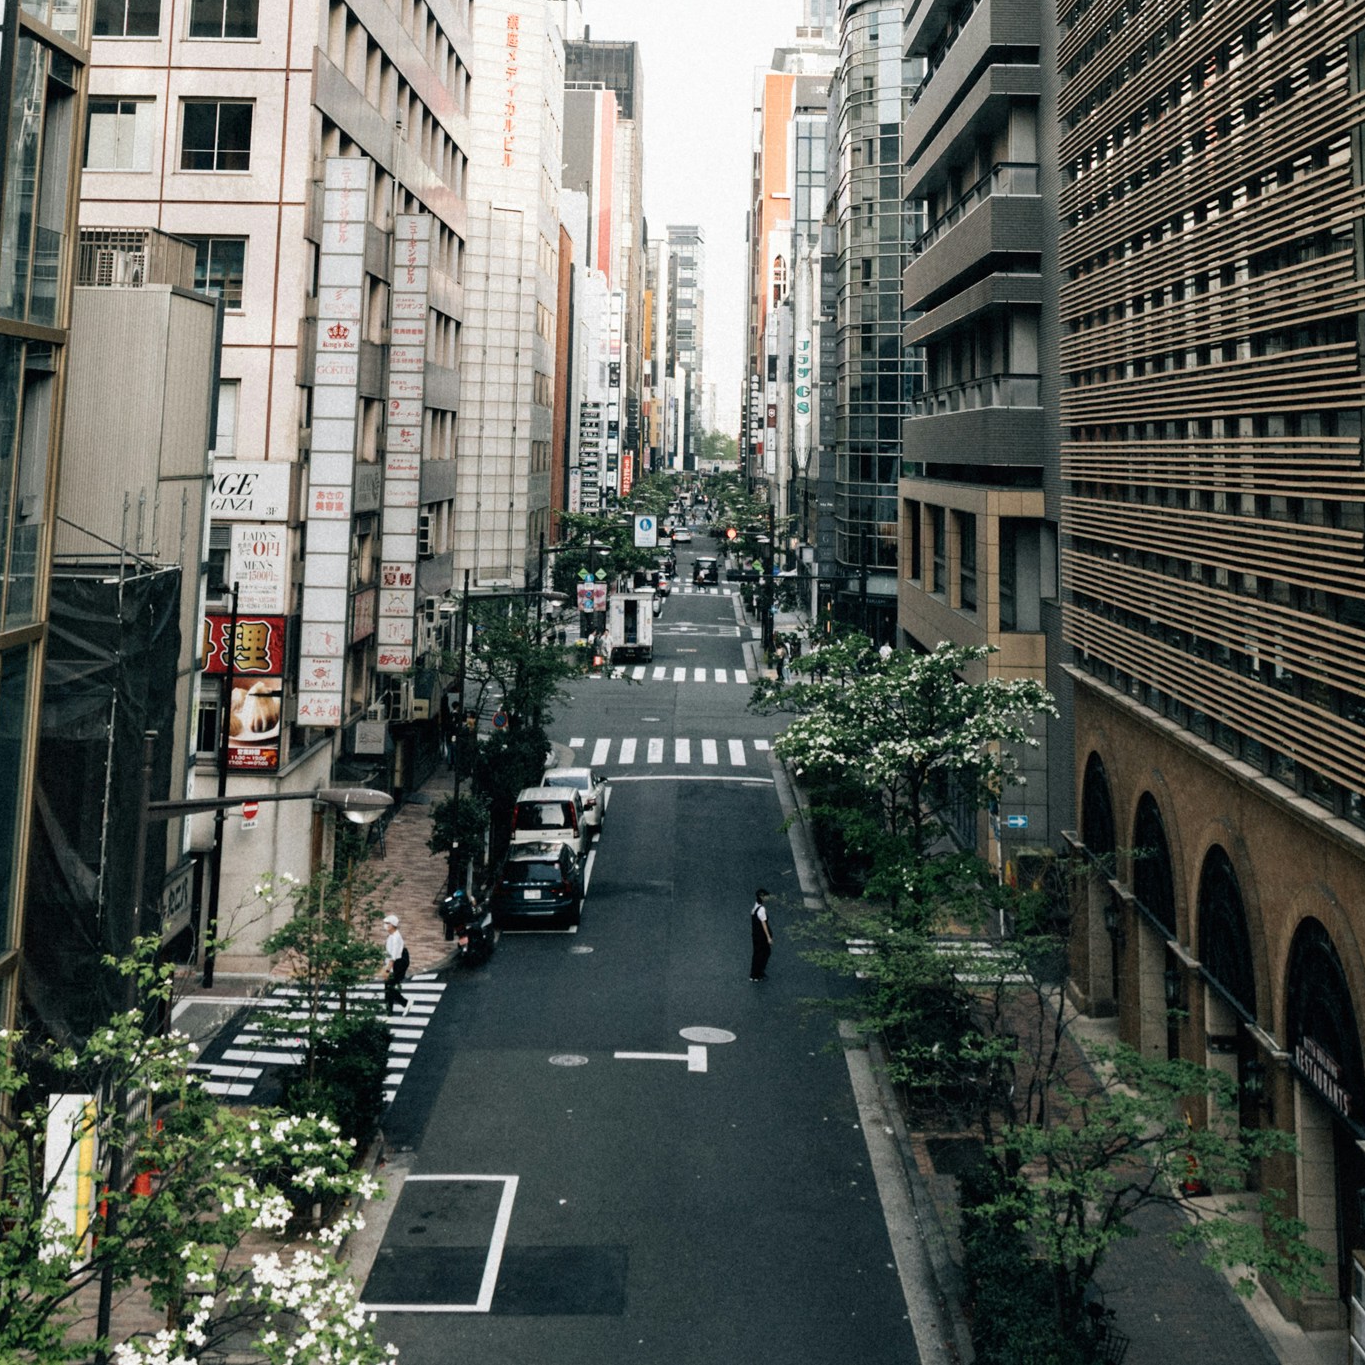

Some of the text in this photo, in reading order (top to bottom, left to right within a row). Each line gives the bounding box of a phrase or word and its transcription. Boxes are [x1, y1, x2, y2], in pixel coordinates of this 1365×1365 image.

[316, 490, 345, 500] あさの
[210, 498, 254, 511] GINZA
[265, 507, 278, 516] 3F
[1295, 1044, 1350, 1117] RESTAURANTS
